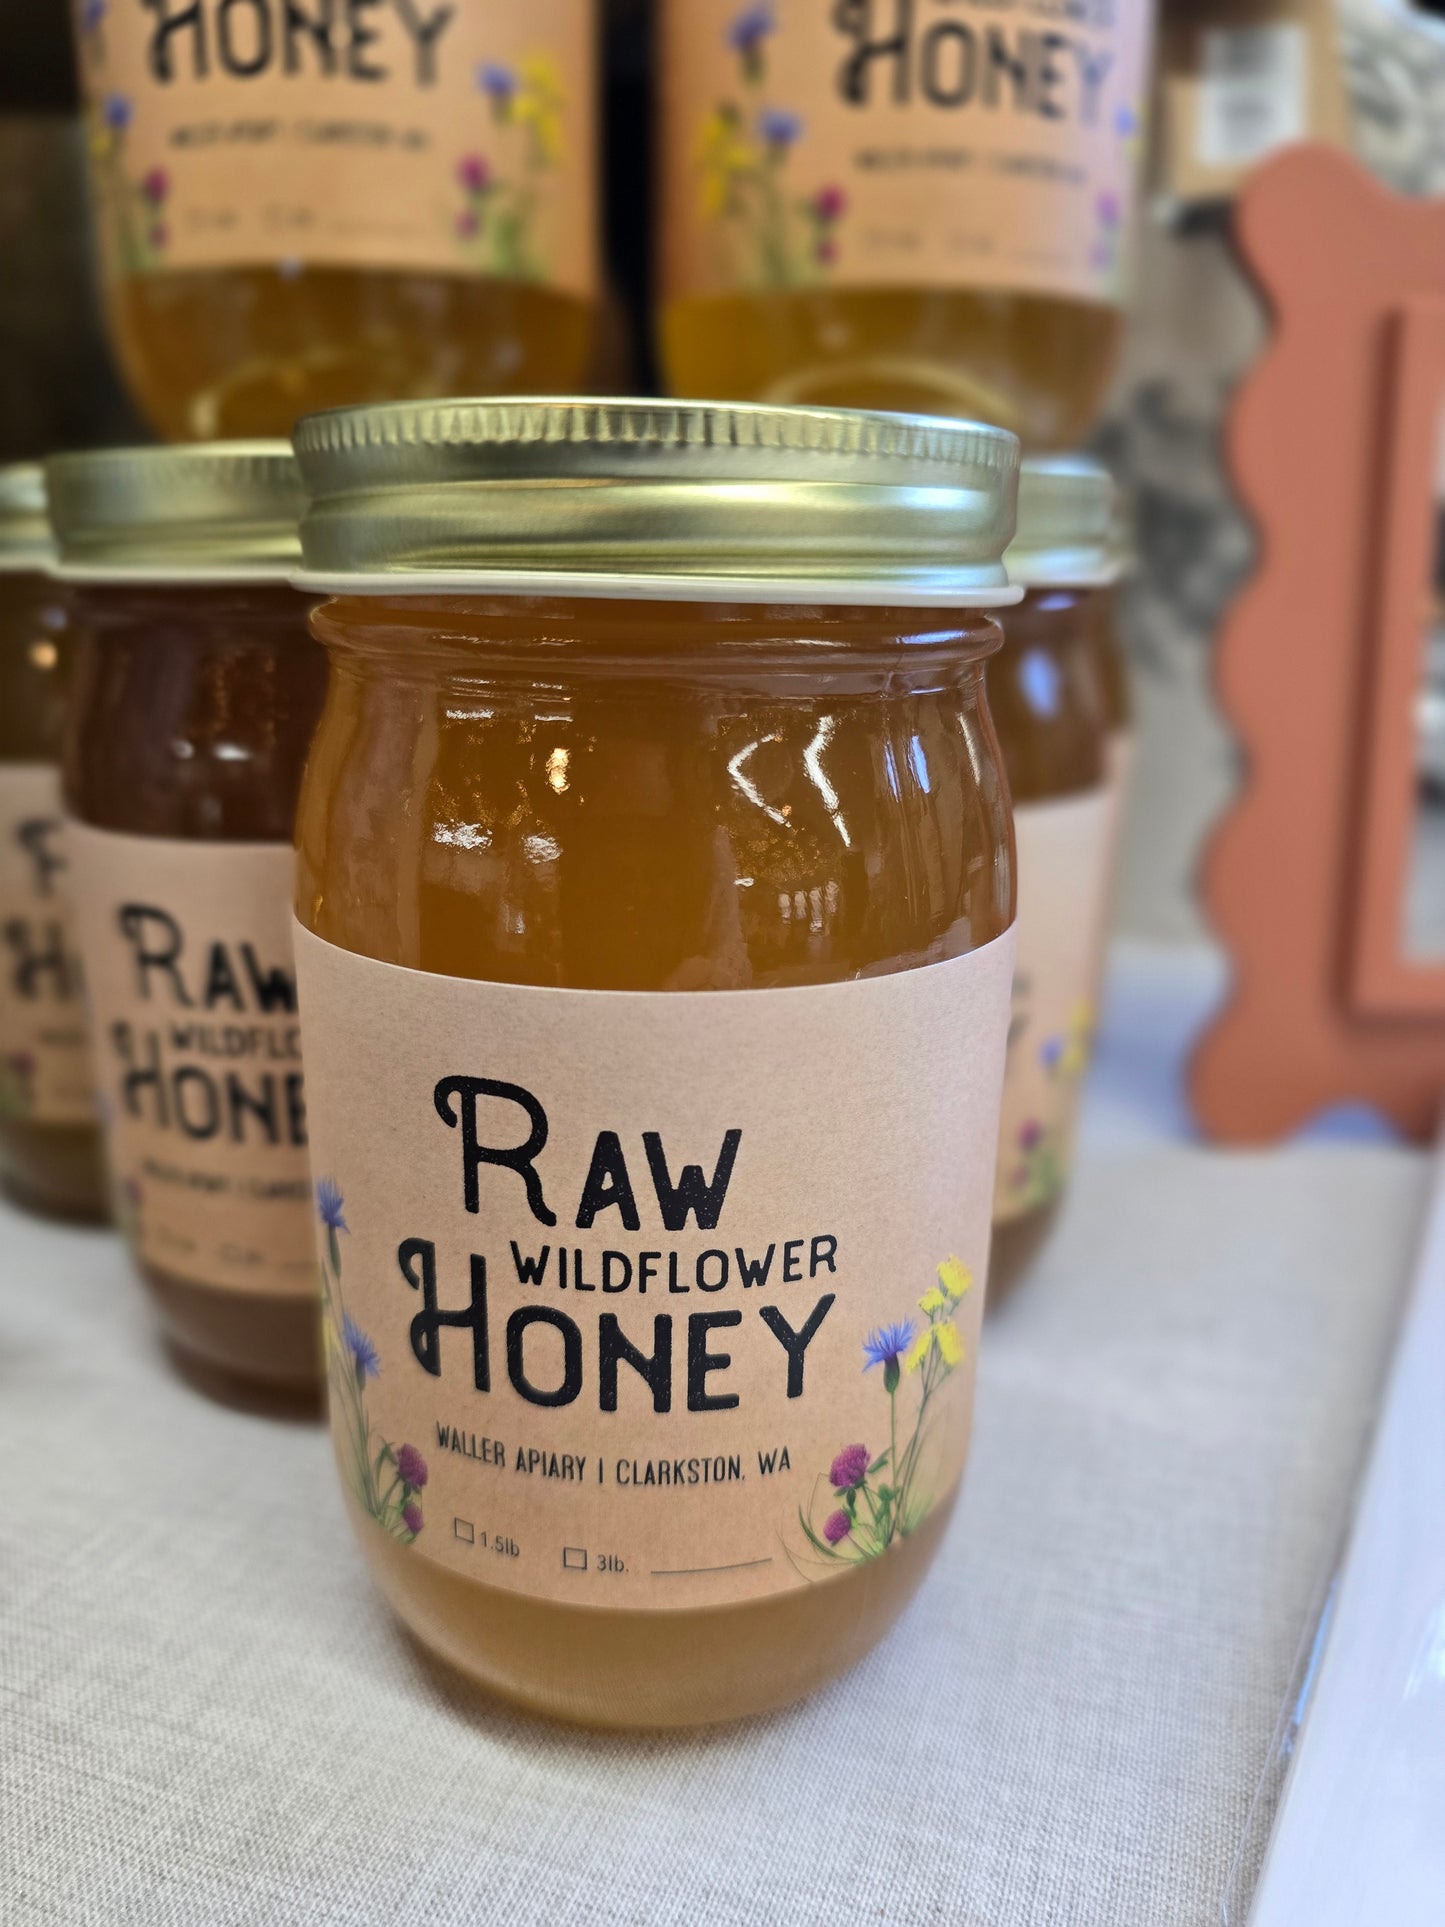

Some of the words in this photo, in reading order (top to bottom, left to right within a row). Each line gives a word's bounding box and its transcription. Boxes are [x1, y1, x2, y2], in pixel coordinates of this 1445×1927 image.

[832, 0, 1115, 124] HONEY
[118, 902, 298, 1014] RAW
[111, 1020, 309, 1147] HONE
[172, 1020, 302, 1060] WILDFLO
[434, 1075, 742, 1231] RAW
[510, 1234, 837, 1293] WILDFLOWER
[399, 1237, 836, 1413] HONEY
[436, 1420, 506, 1467] WALLER
[515, 1446, 587, 1481] APIARY
[757, 1446, 791, 1475] WA
[480, 1531, 520, 1557] 1.5lb
[597, 1554, 629, 1573] 3lb.
